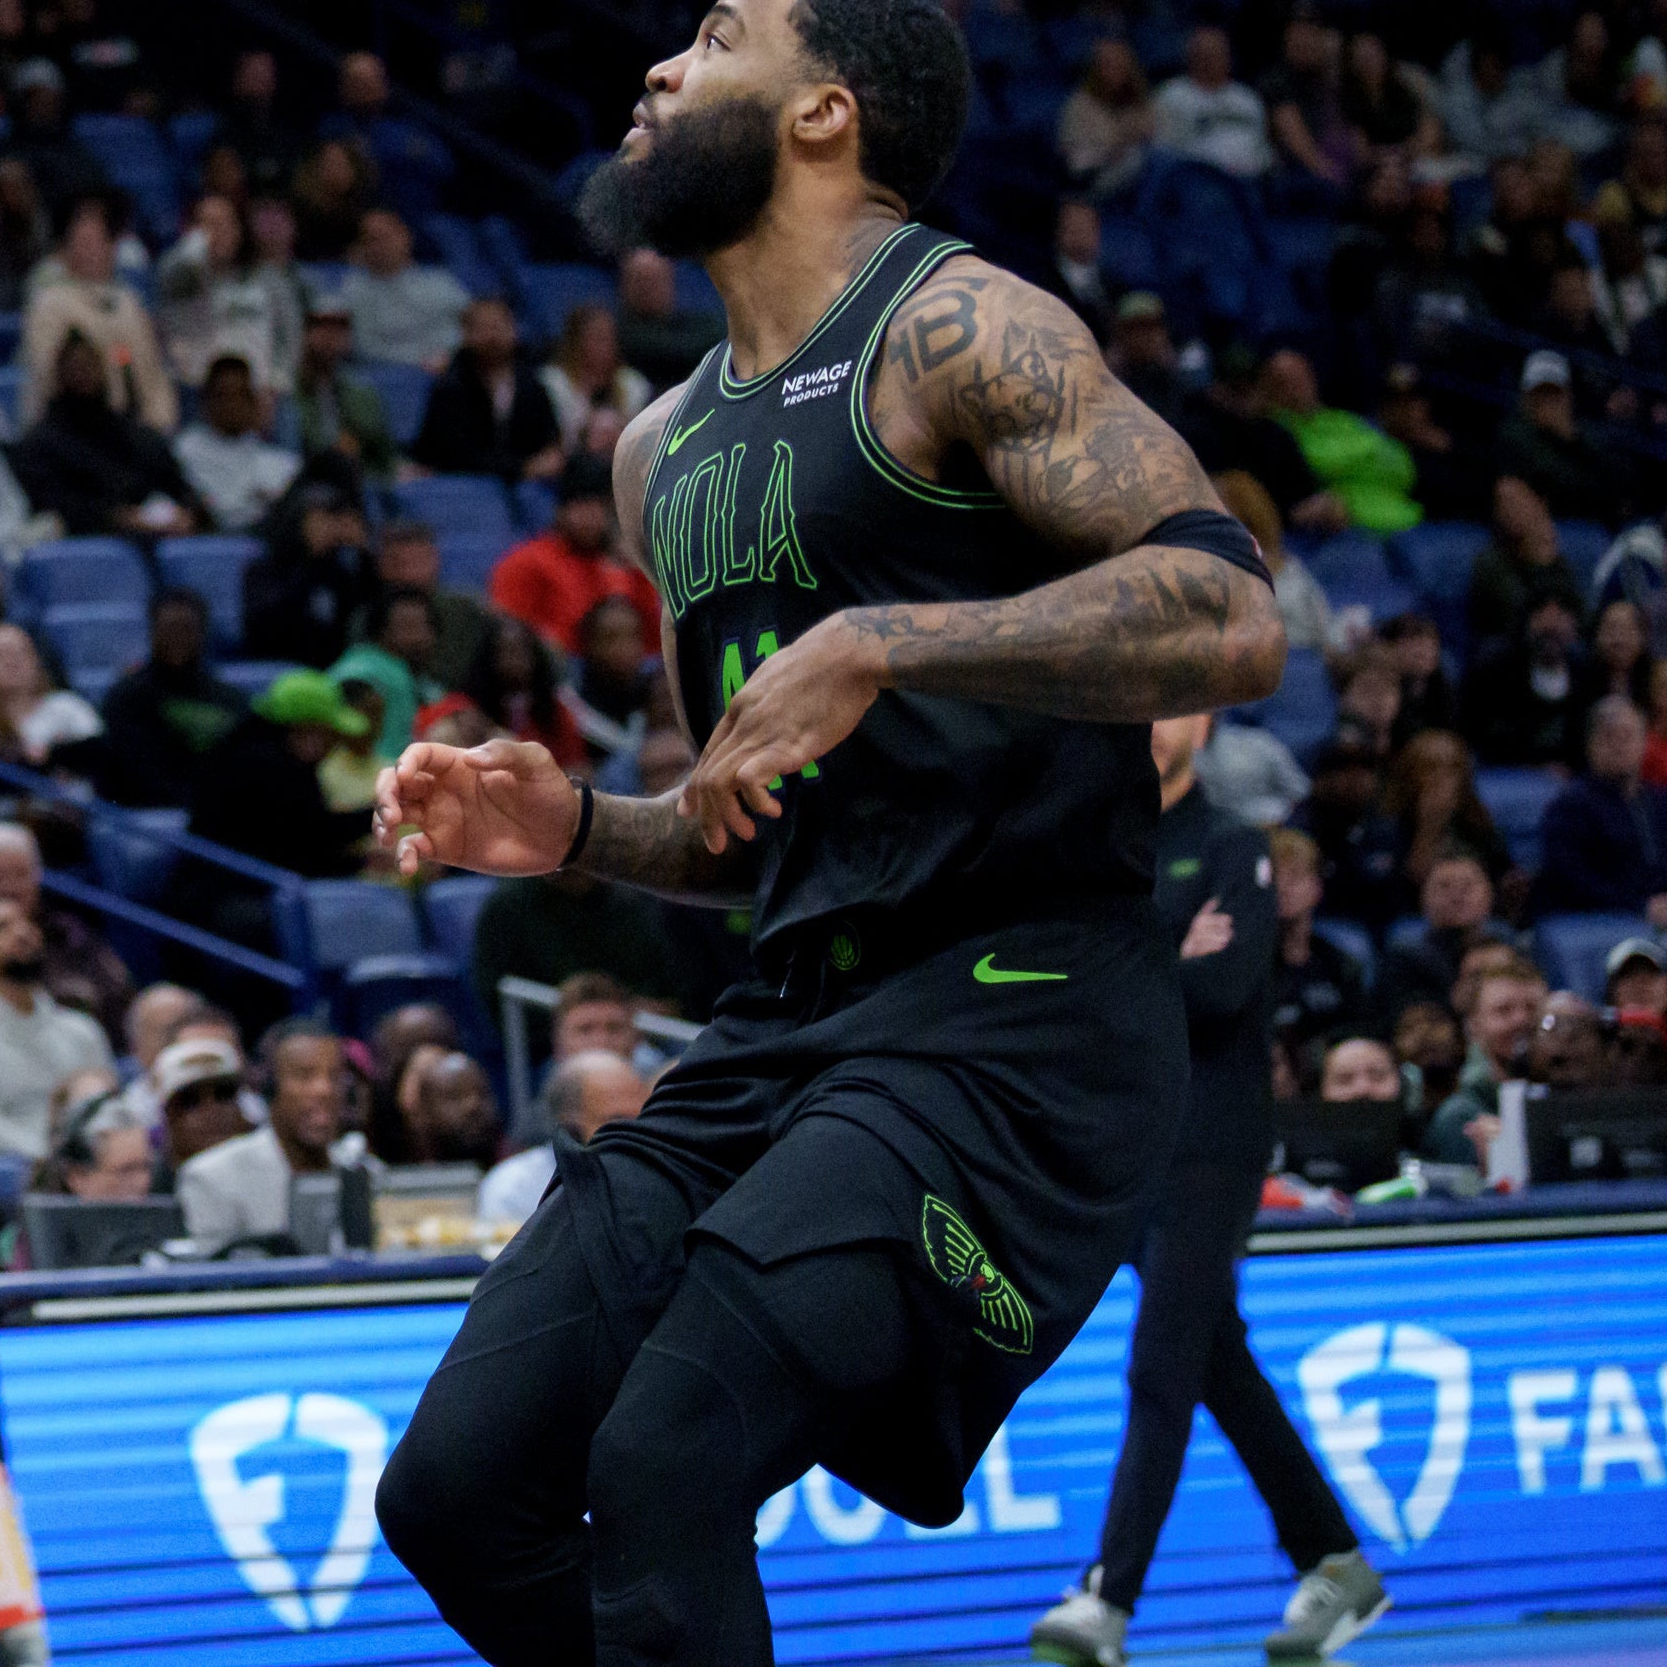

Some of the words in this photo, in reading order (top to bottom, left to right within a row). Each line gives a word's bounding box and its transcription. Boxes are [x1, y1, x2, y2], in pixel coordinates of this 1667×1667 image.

[780, 359, 853, 396] NEWAGE
[783, 382, 840, 408] PRODUCTS
[651, 438, 819, 621] NOLA
[1507, 1363, 1667, 1495] FA
